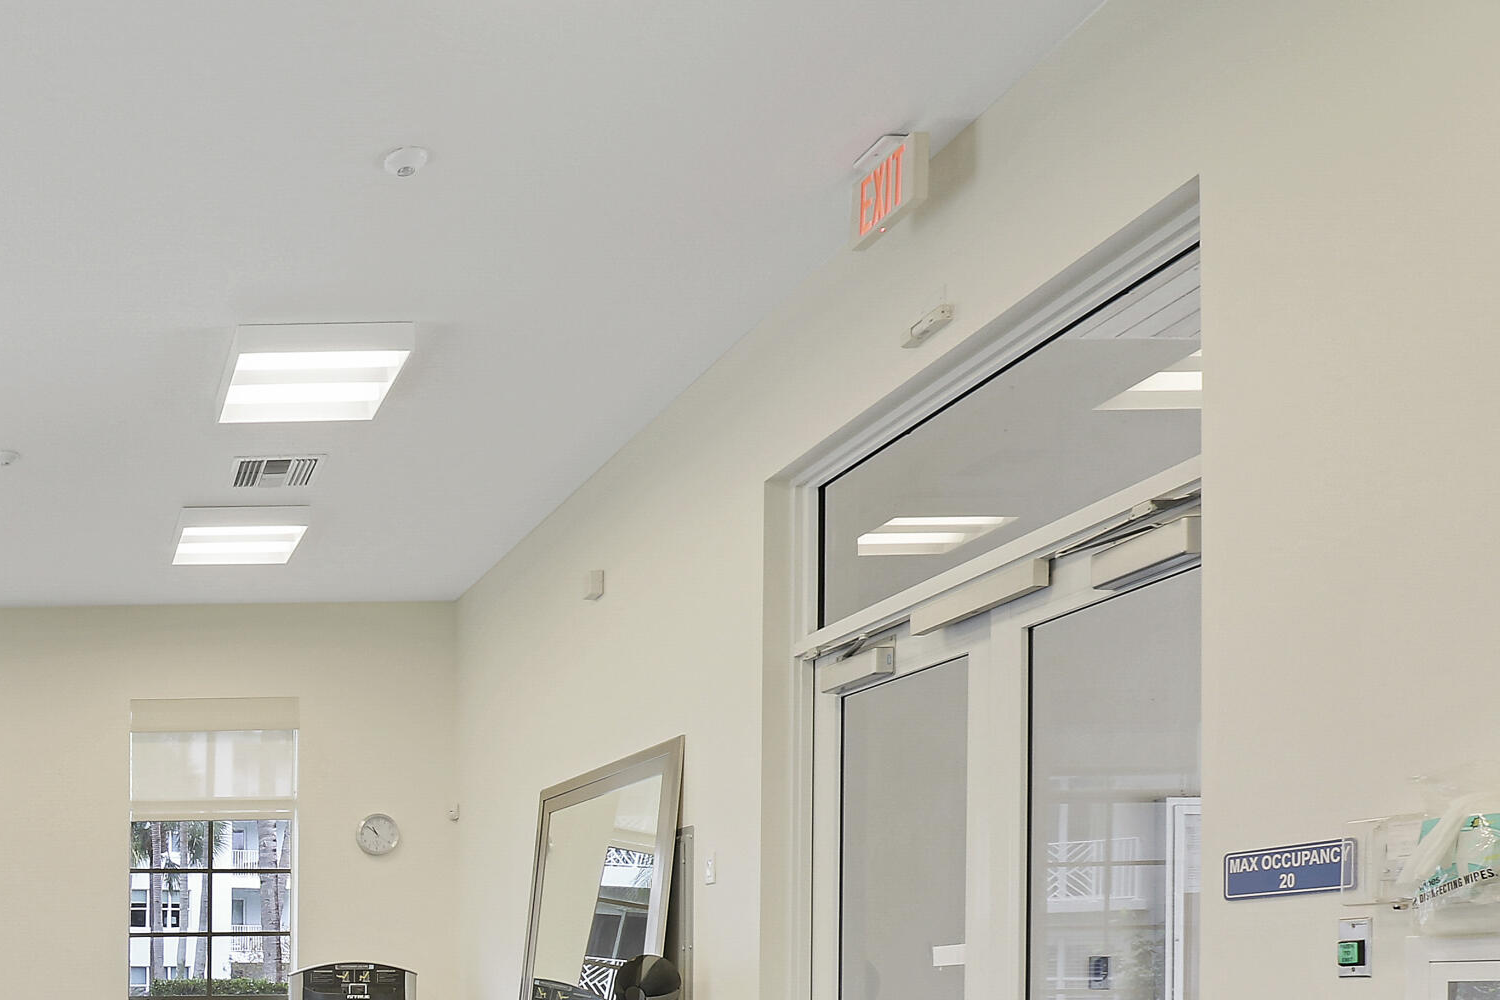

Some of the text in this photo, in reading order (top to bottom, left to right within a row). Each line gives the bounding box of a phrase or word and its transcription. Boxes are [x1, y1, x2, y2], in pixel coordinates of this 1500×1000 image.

[860, 144, 905, 236] EXIT
[1229, 845, 1352, 874] MAX OCCUPANCY
[1279, 873, 1295, 889] 20
[1419, 877, 1463, 904] DINFECTING
